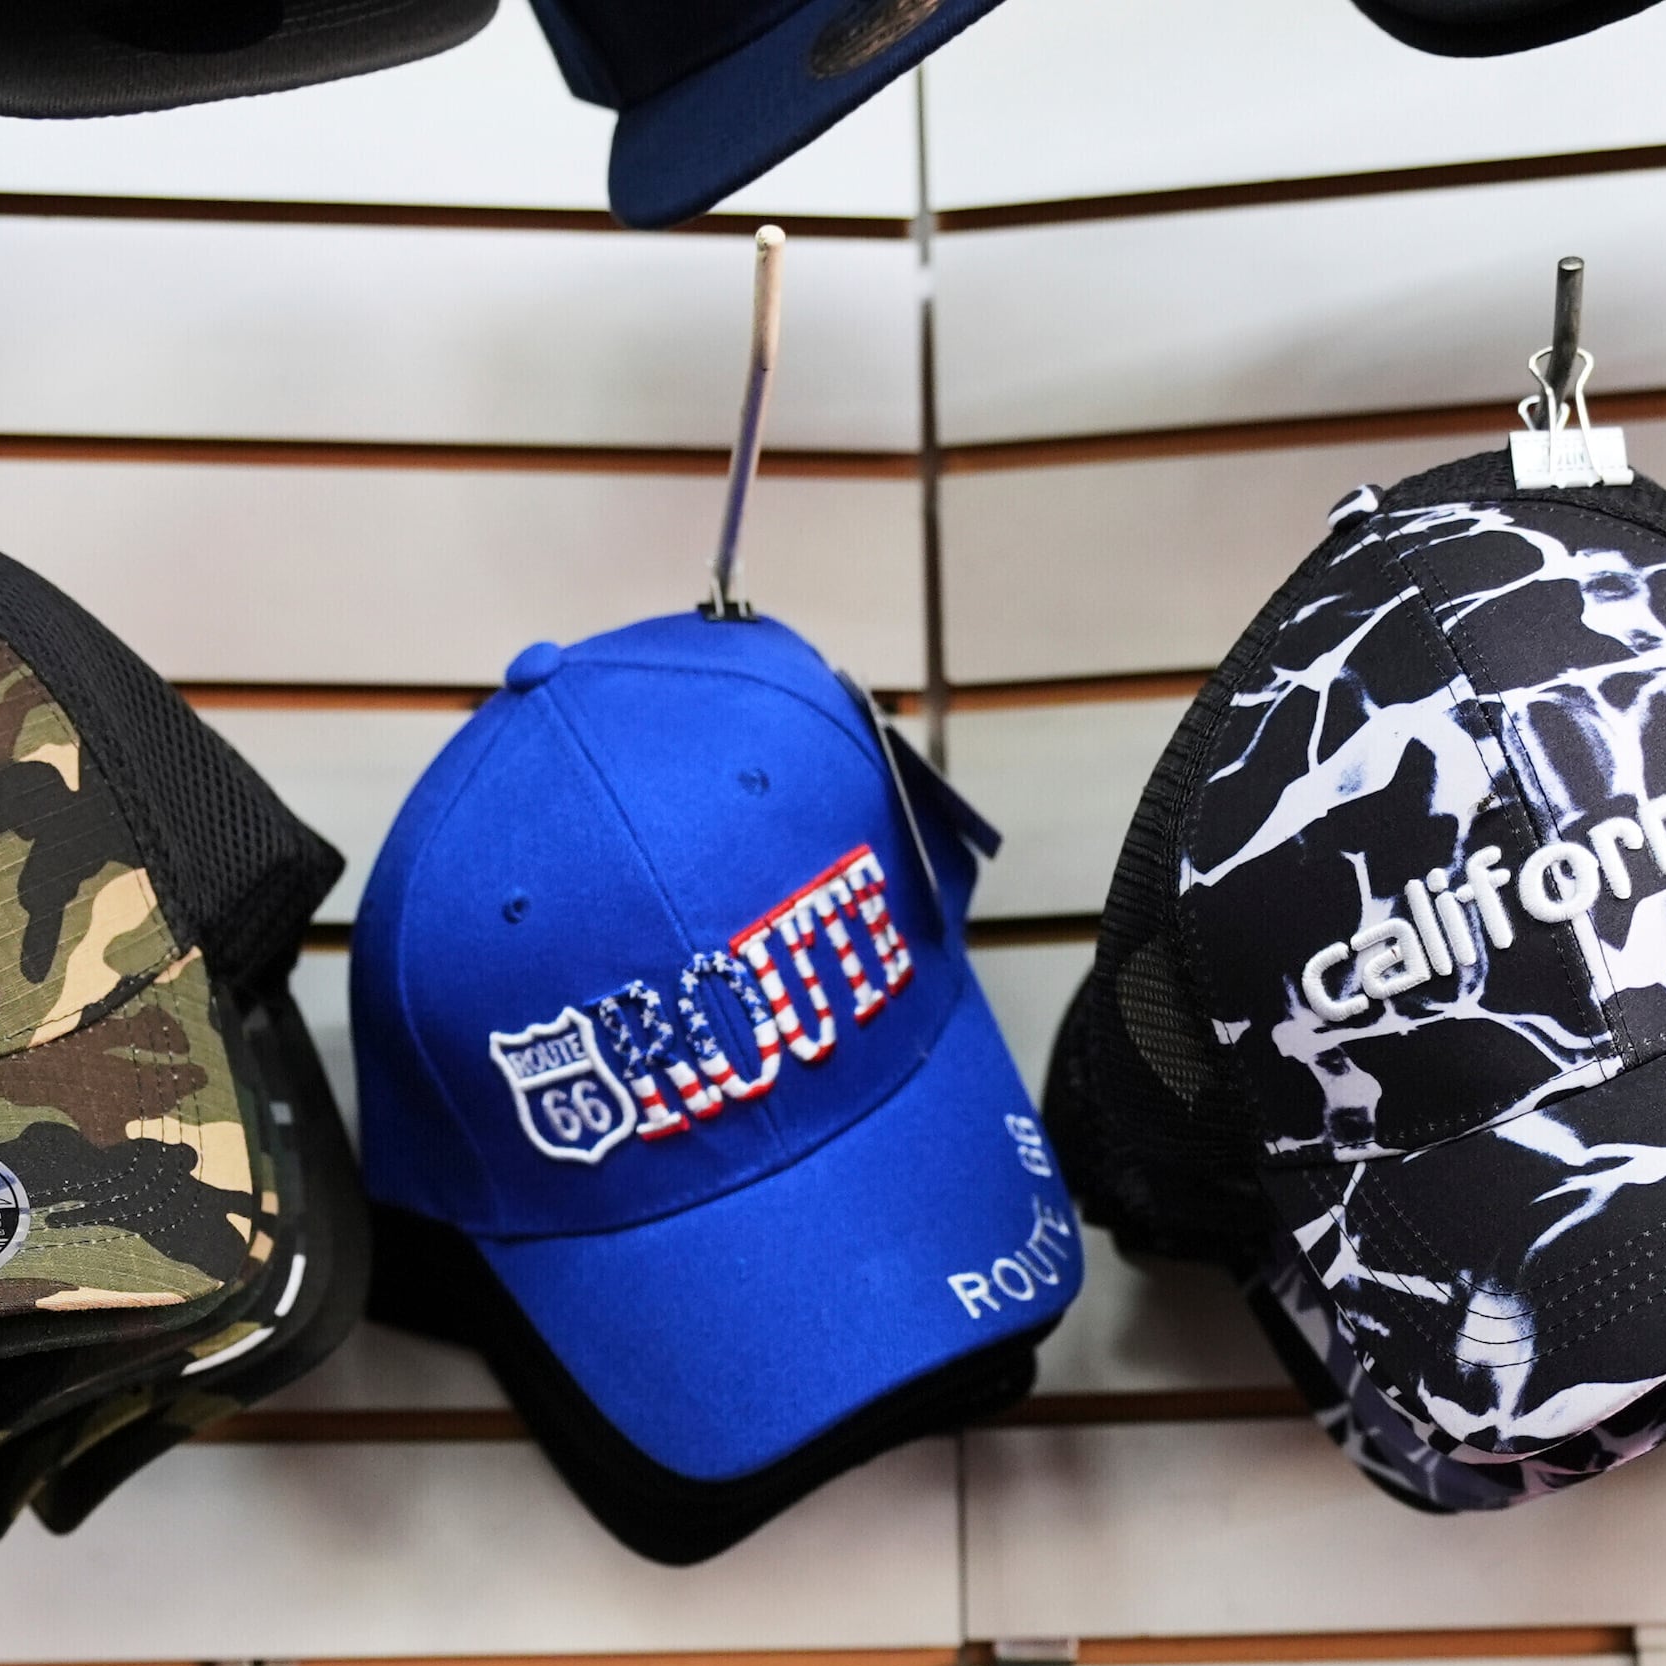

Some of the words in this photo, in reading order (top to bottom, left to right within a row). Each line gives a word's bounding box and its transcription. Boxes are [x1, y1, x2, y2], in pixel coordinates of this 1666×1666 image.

[583, 843, 914, 1141] ROUTE
[507, 1032, 588, 1080] ROUTE
[542, 1080, 612, 1142] 66
[946, 1192, 1071, 1320] ROUTE
